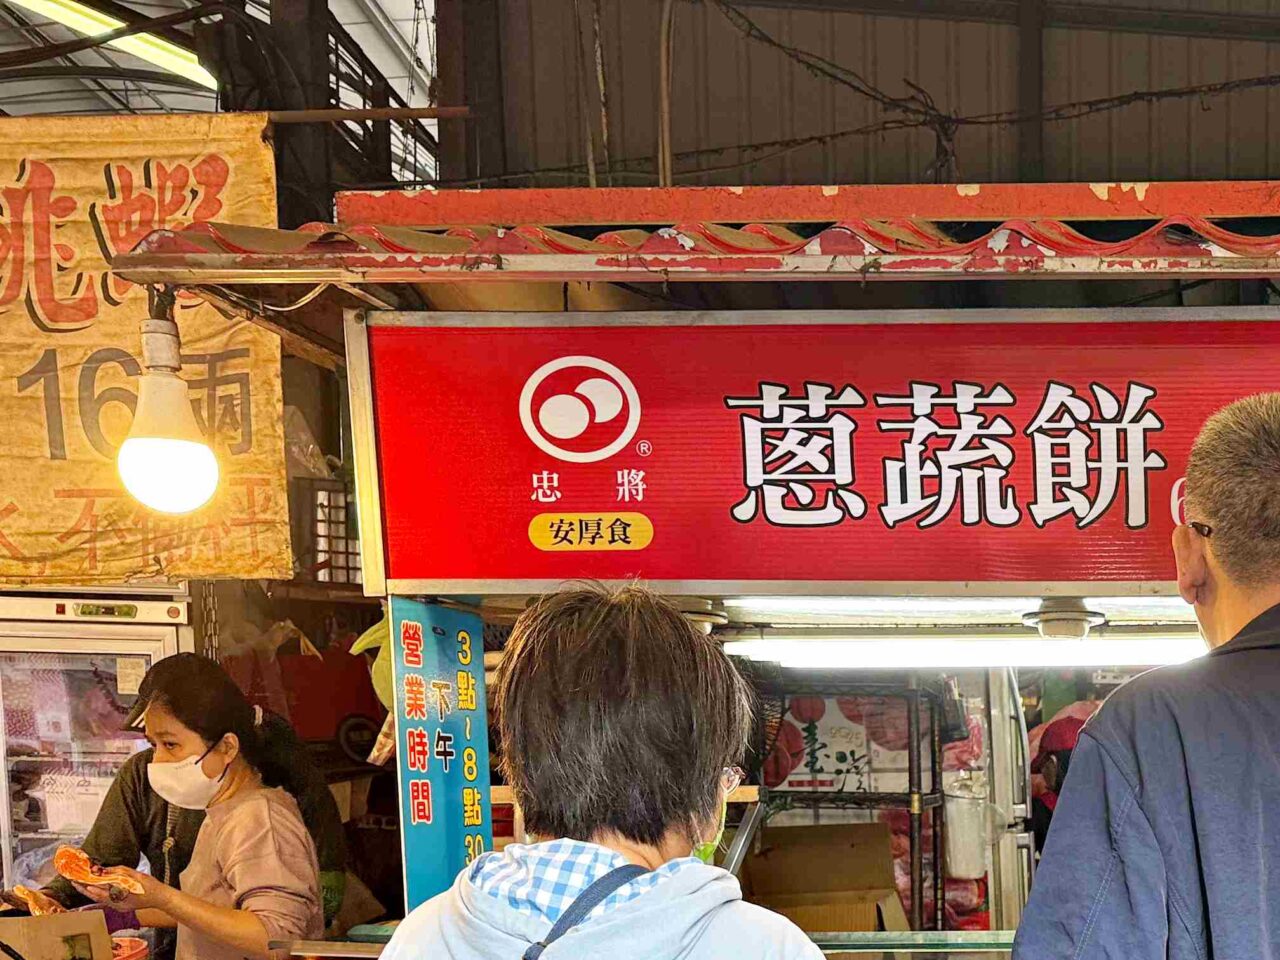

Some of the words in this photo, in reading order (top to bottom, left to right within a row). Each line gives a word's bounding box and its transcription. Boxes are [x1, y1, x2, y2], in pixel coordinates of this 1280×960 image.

[549, 518, 632, 546] 安厚食
[402, 620, 432, 825] 營業時間
[431, 680, 455, 773] 下午
